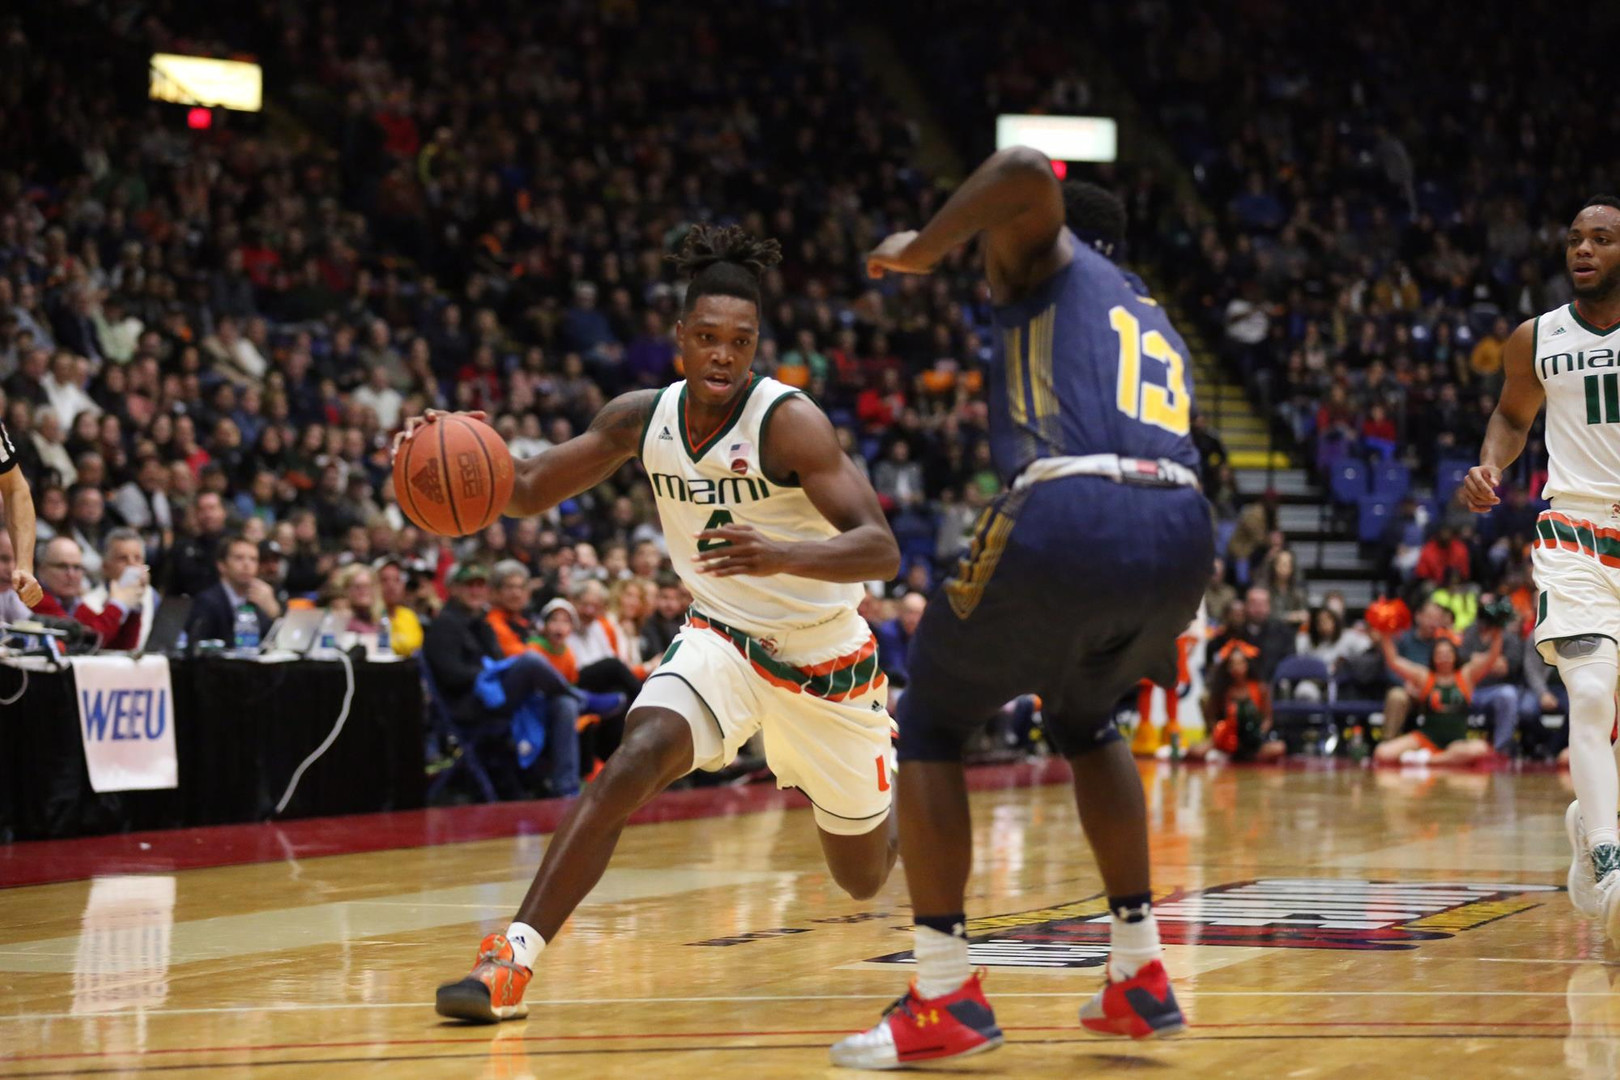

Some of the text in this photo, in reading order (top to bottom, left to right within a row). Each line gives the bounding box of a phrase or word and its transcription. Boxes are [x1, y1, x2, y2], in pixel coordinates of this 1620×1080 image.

[1108, 305, 1191, 437] 13
[1541, 348, 1620, 380] mia
[1584, 372, 1620, 425] 11
[652, 472, 770, 505] mami
[697, 509, 736, 553] 4
[82, 688, 166, 741] WEEU
